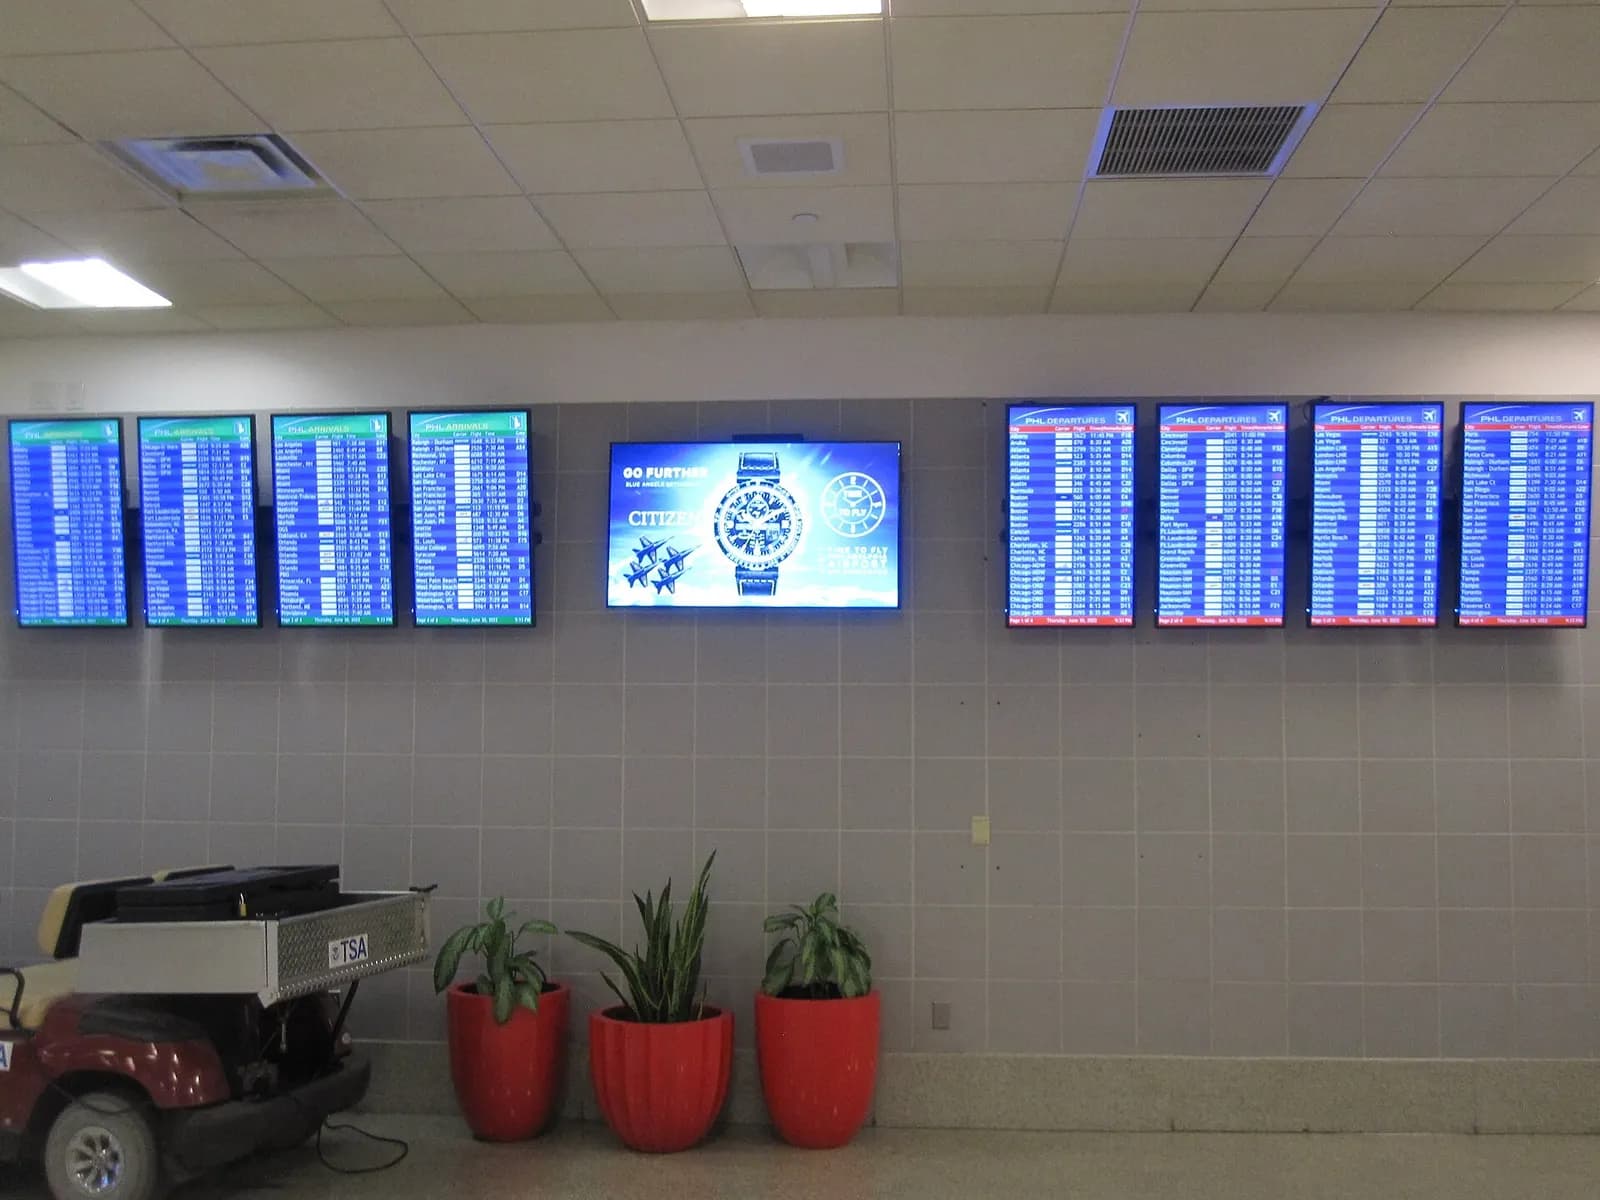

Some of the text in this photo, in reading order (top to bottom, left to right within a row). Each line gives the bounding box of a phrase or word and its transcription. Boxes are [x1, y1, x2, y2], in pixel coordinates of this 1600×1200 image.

[425, 424, 443, 432] PHL
[623, 467, 643, 479] GO
[341, 936, 366, 962] TSA
